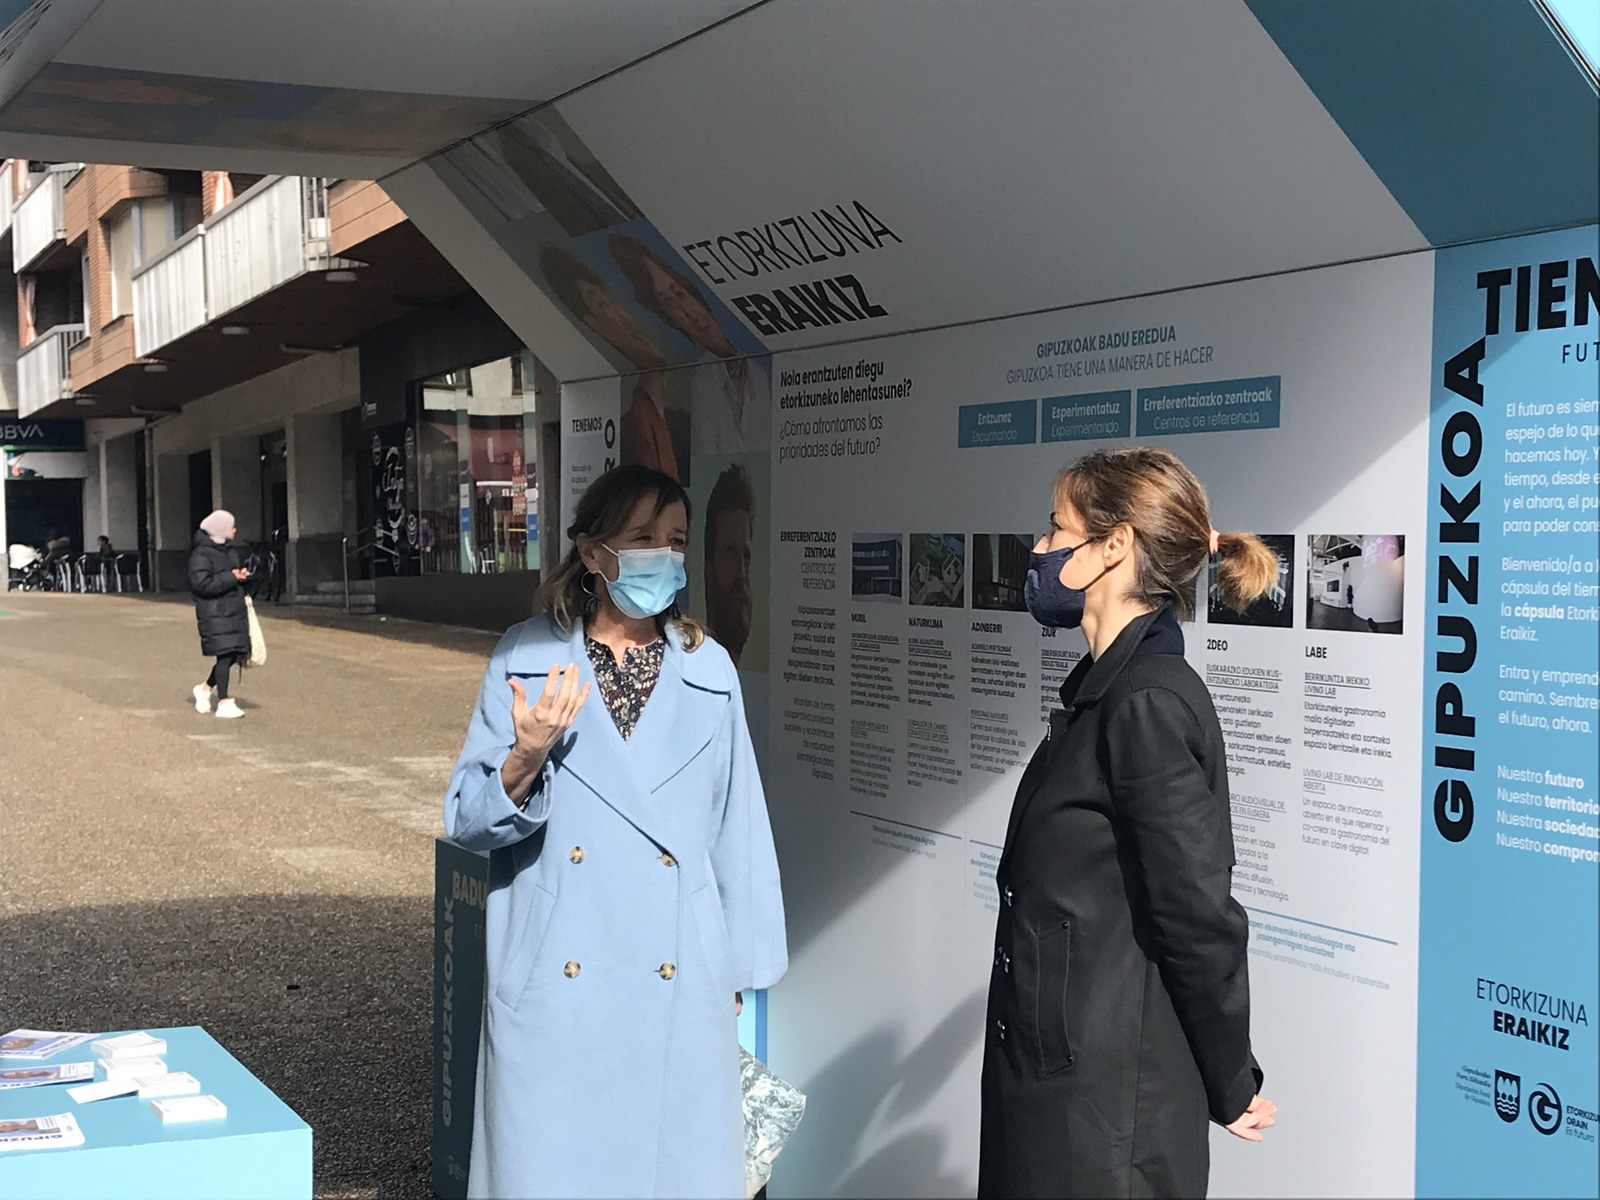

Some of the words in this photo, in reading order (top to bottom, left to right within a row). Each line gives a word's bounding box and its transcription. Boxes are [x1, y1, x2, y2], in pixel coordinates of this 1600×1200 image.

[682, 200, 903, 285] ETORKIZUNA
[731, 274, 889, 336] ERAIKIZ
[1036, 335, 1097, 358] GIPUZKOAK
[1099, 334, 1129, 352] BADU
[1131, 325, 1176, 347] EREDUA
[780, 370, 801, 388] Nola
[802, 365, 853, 386] erantzuten
[855, 359, 884, 383] diegu
[1006, 366, 1053, 385] GIPUZKOA
[1057, 361, 1082, 379] TIENE
[1085, 360, 1106, 376] UNA
[1109, 354, 1153, 374] MANERA
[1157, 352, 1171, 369] DE
[1174, 346, 1214, 367] HACER
[780, 388, 838, 410] etorkizuneko
[840, 378, 913, 404] lehentasunei?
[1143, 392, 1223, 412] Erreferentziazko
[1225, 387, 1273, 406] zentroak
[978, 413, 1012, 426] Entzunez
[1052, 402, 1121, 423] Esperimentatuz
[1153, 415, 1191, 431] Centros
[1192, 414, 1206, 428] de
[1207, 409, 1260, 426] referencia
[1505, 402, 1515, 418] El
[1517, 402, 1554, 418] futuro
[1556, 402, 1572, 415] es
[572, 416, 603, 433] TENEMOS
[812, 416, 867, 435] afrontamos
[868, 413, 883, 431] las
[1505, 424, 1545, 444] espejo
[1547, 423, 1564, 439] de
[1566, 422, 1578, 438] lo
[779, 440, 829, 464] prioridades
[830, 439, 846, 457] del
[847, 436, 881, 456] futuro?
[1504, 448, 1561, 463] hacemos
[1564, 446, 1590, 466] hoy.
[1504, 472, 1549, 490] tiempo,
[1551, 470, 1591, 486] desde
[1502, 497, 1511, 514] y
[1512, 494, 1524, 509] el
[1526, 494, 1565, 511] ahora,
[1567, 494, 1579, 509] el
[780, 531, 837, 543] ERREFERENTZIAZKO
[1502, 520, 1531, 537] para
[1533, 517, 1570, 537] poder
[804, 547, 836, 559] ZENTROAK
[1501, 554, 1582, 575] Bienvenido/a
[1584, 561, 1594, 573] a
[1434, 335, 1486, 843] GIPUZKOA
[1500, 579, 1549, 598] cápsula
[1551, 581, 1571, 596] del
[1500, 602, 1512, 617] la
[1514, 602, 1565, 623] cápsula
[908, 618, 943, 630] NATURKLIMA
[971, 622, 1003, 634] ADINBERRI
[1500, 625, 1540, 641] Eraikiz.
[1206, 638, 1228, 651] 2DEO
[1305, 645, 1327, 659] LABE
[1499, 664, 1530, 680] Entra
[1532, 669, 1540, 685] y
[1498, 688, 1548, 705] camino.
[1498, 710, 1510, 725] el
[1511, 711, 1550, 731] futuro,
[1551, 715, 1592, 733] ahora.
[1497, 764, 1543, 784] Nuestro
[1544, 769, 1584, 790] futuro
[1496, 786, 1543, 807] Nuestro
[1496, 809, 1543, 830] Nuestra
[1496, 832, 1542, 853] Nuestro
[442, 895, 456, 1128] GIPUZKOAK
[1476, 978, 1589, 1027] ETORKIZUNA
[1493, 1009, 1570, 1052] ERAIKIZ
[1566, 1116, 1588, 1130] ORAIN
